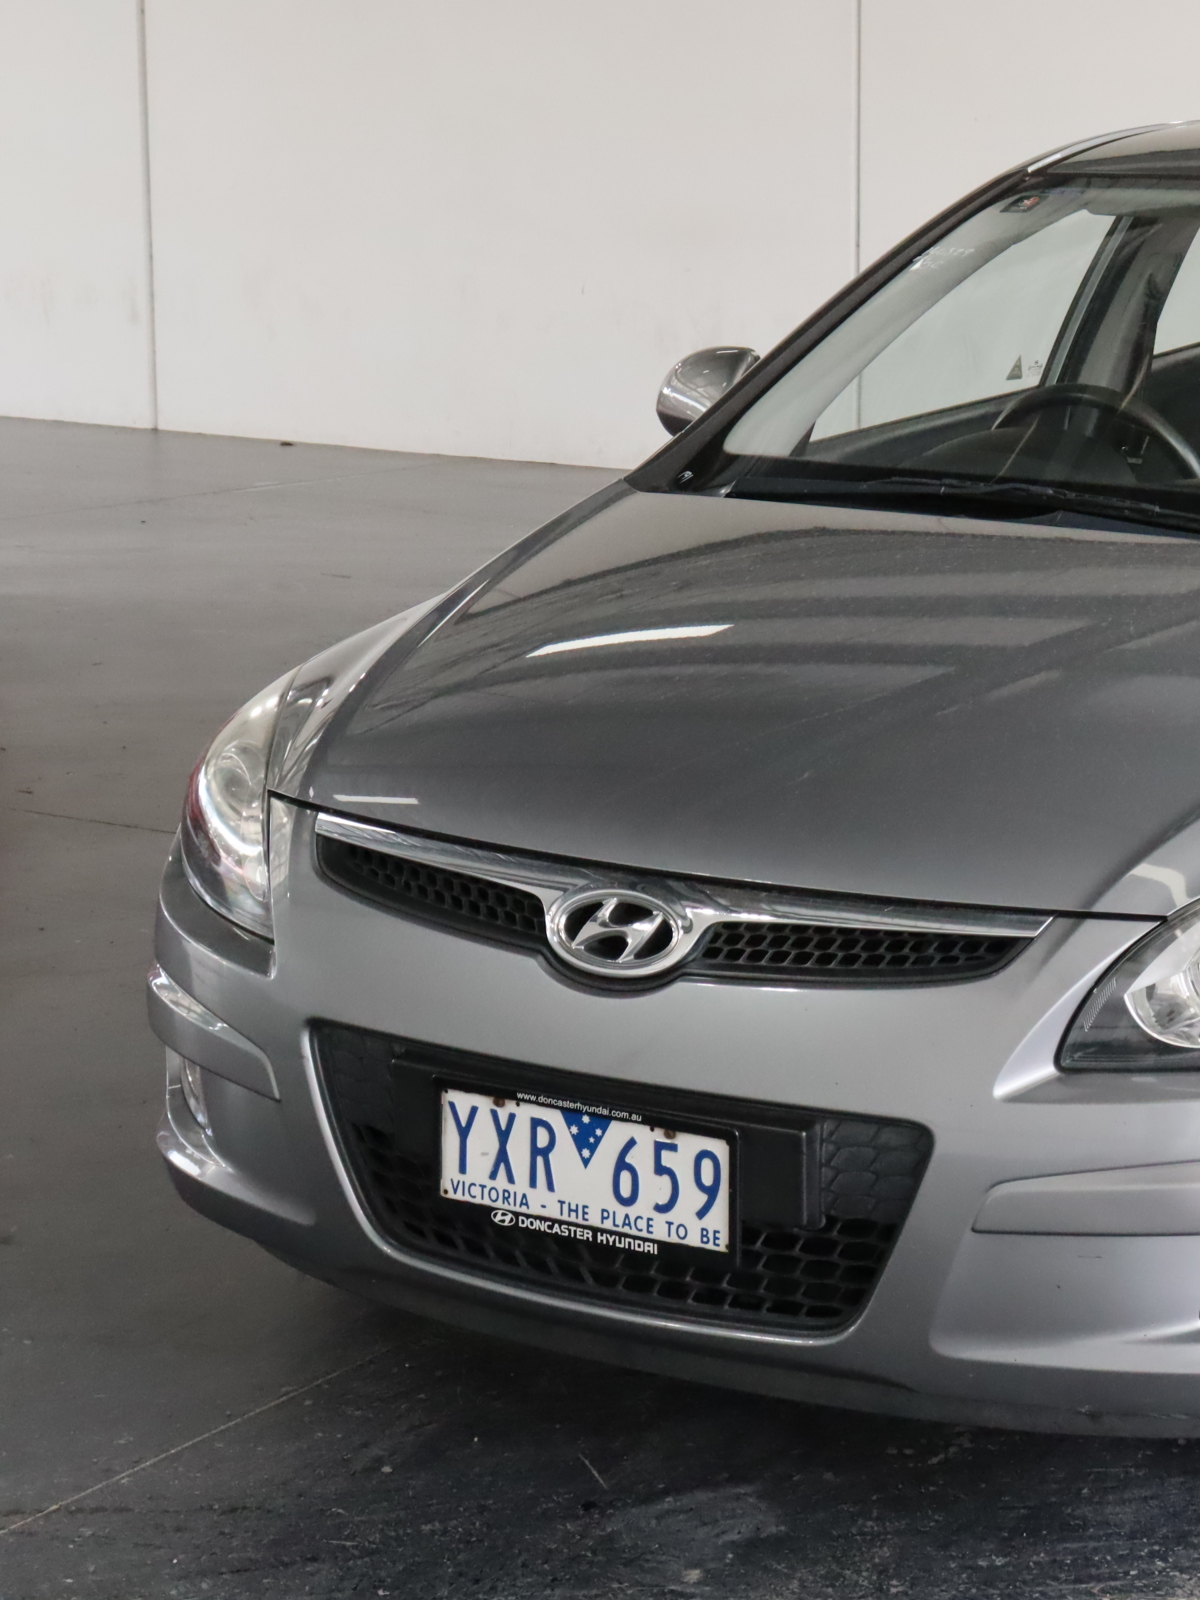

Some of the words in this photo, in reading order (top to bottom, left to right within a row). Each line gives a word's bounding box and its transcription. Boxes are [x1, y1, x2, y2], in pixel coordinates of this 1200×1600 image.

[516, 1092, 642, 1121] www.doncasterhyundai.com.au
[448, 1100, 557, 1193] YXR
[612, 1136, 722, 1220] 659
[450, 1178, 530, 1210] VICTORIA
[557, 1200, 590, 1221] THE
[601, 1208, 654, 1235] PLACE
[665, 1221, 688, 1240] TO
[701, 1227, 721, 1247] BE
[518, 1216, 593, 1242] DONCASTER
[597, 1232, 658, 1255] HYUNDAI
